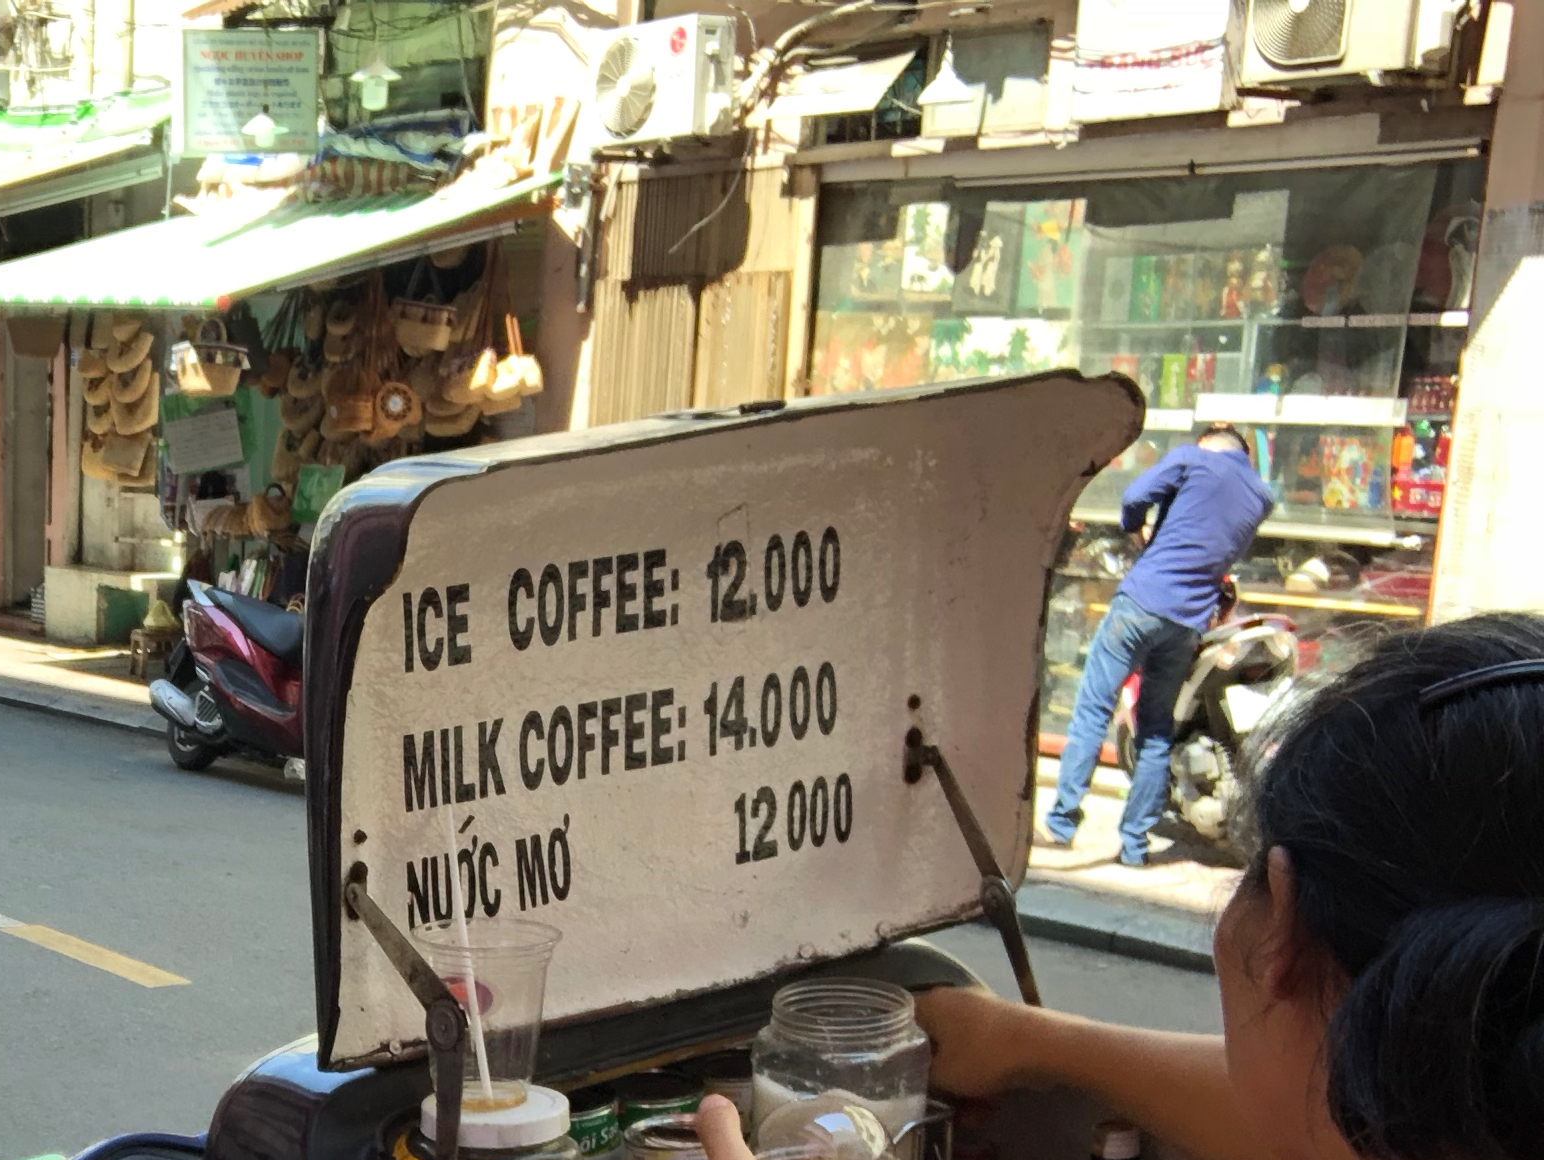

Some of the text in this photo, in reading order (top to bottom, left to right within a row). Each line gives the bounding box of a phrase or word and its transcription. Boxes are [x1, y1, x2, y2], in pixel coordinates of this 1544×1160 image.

[402, 526, 841, 673] ICE COFFEE: 12.000
[403, 661, 837, 813] MILK COFFEE: 14.000
